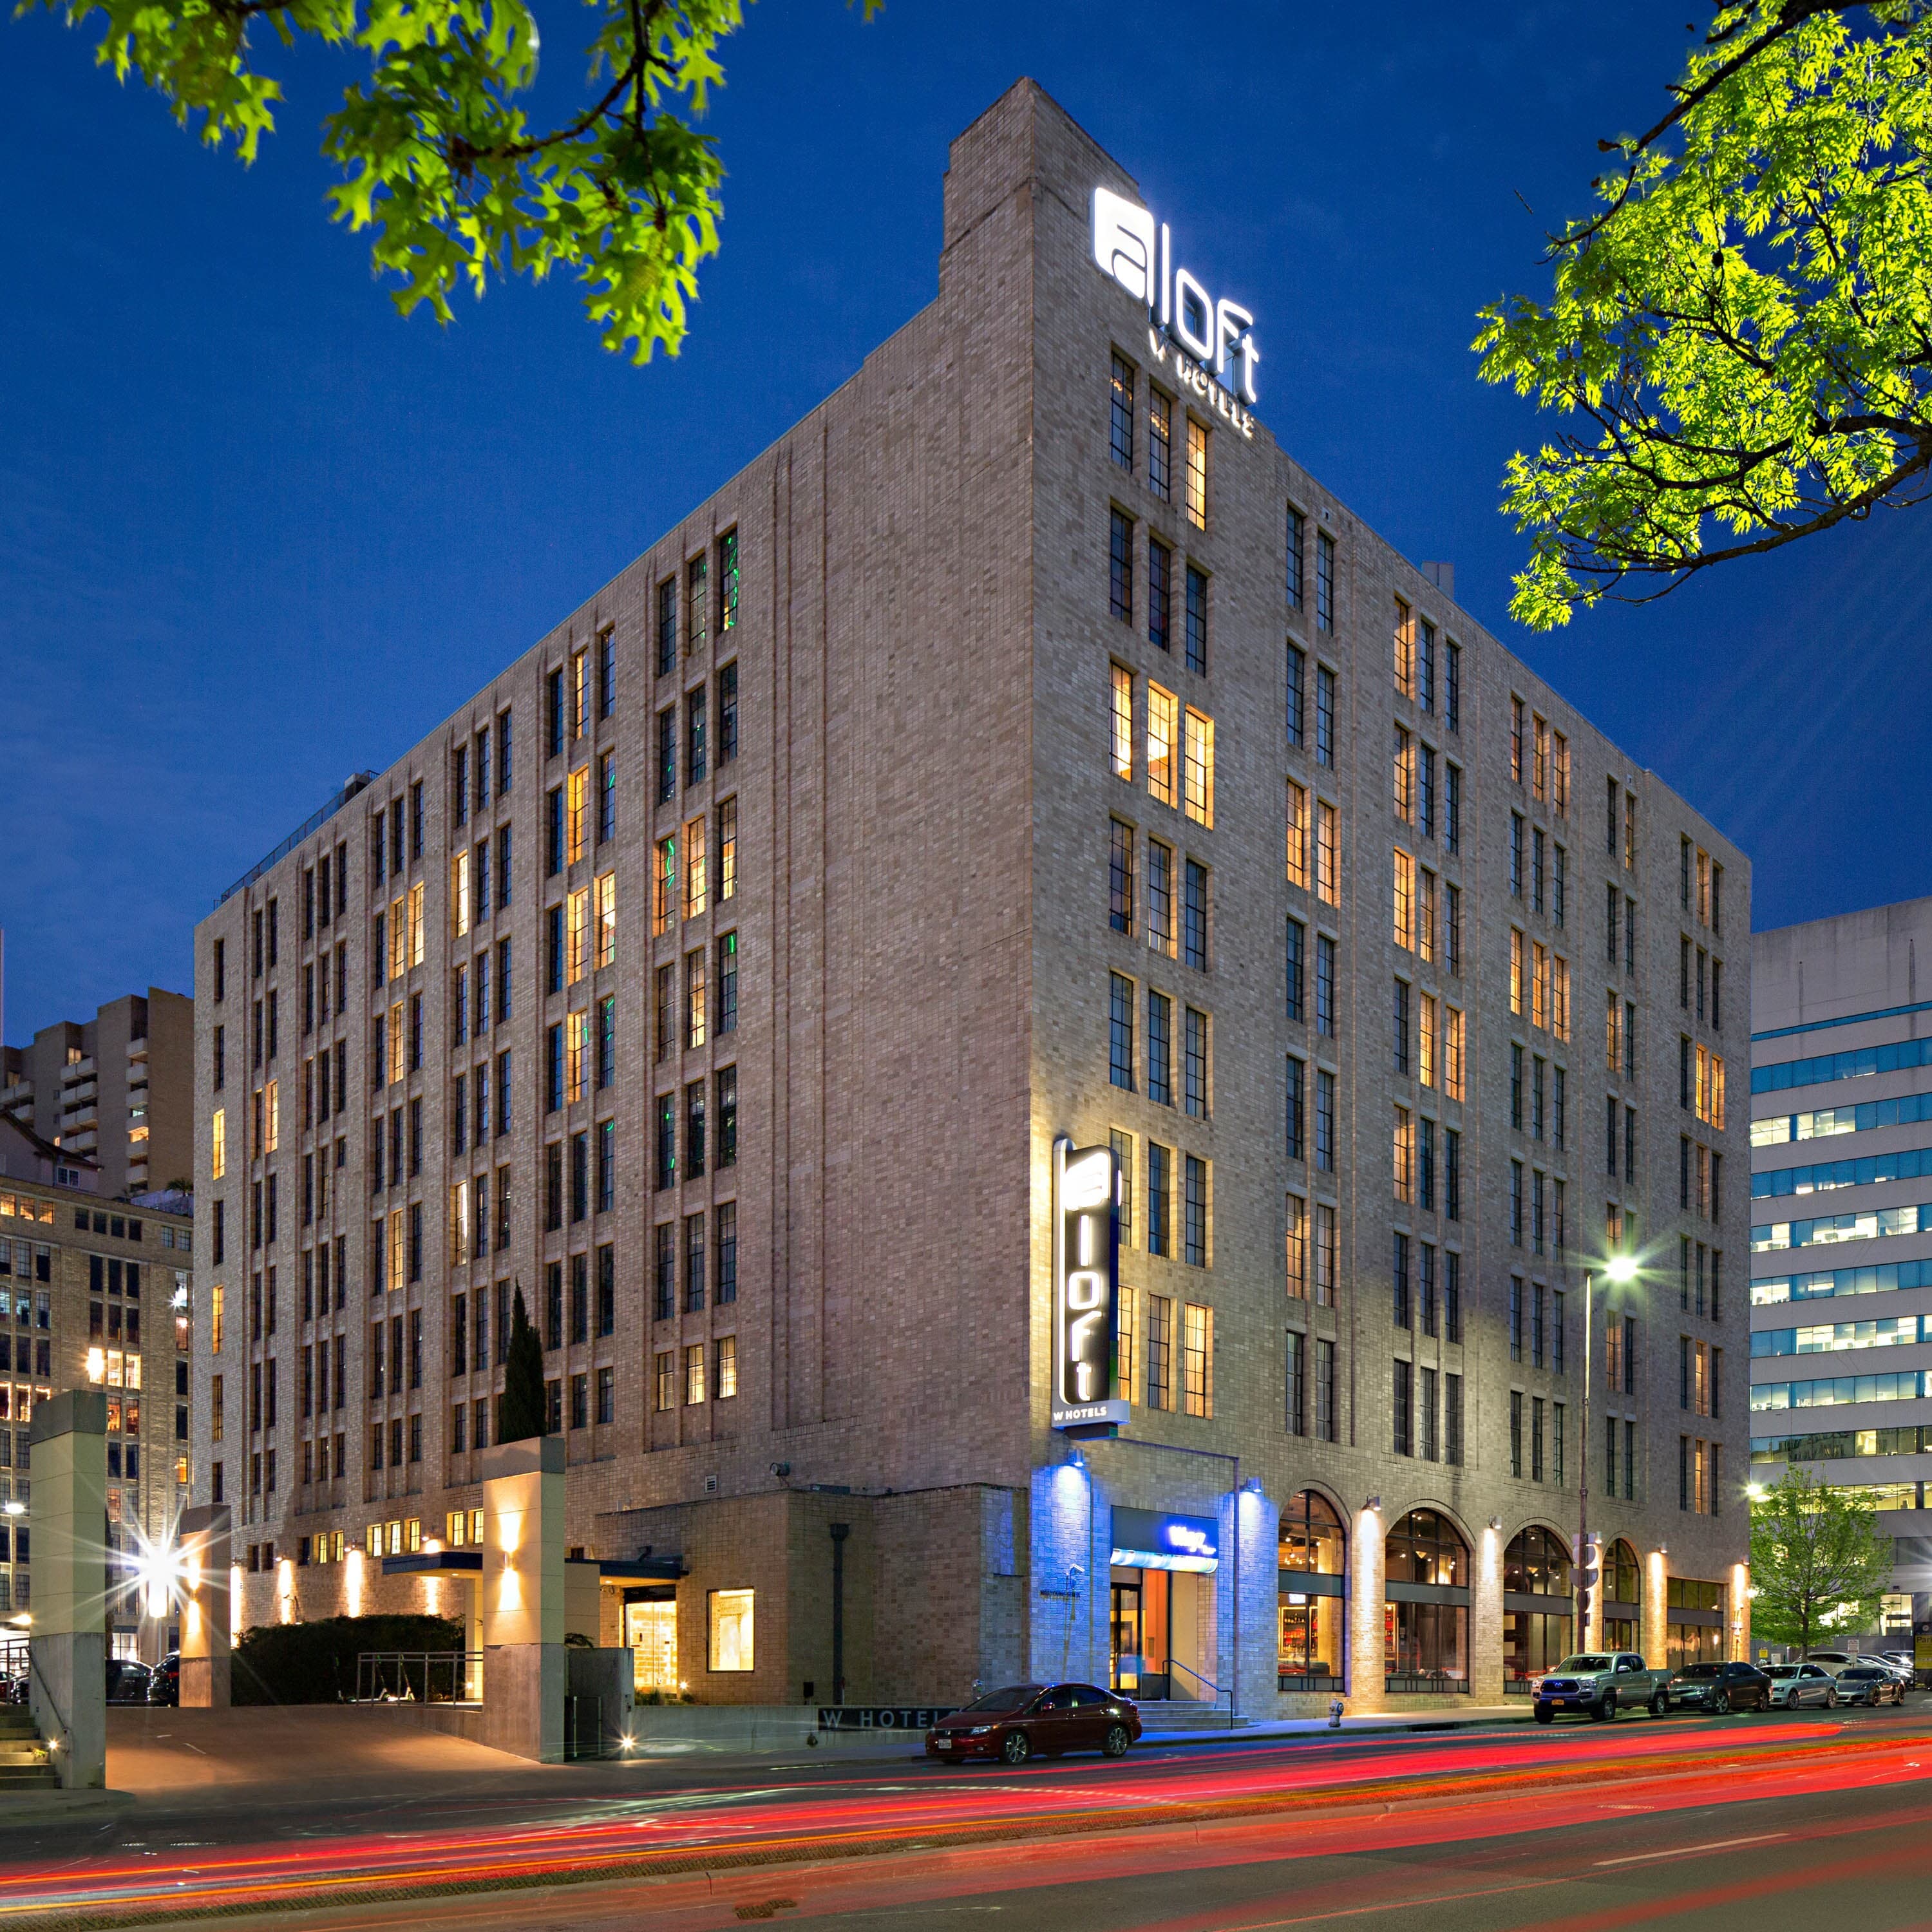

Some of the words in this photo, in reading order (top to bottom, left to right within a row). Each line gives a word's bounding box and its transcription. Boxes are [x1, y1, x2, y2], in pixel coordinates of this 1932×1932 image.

[1094, 186, 1260, 404] aloft
[1053, 1411, 1064, 1421] W
[1065, 1406, 1107, 1420] HOTELS
[822, 1710, 843, 1728] W
[860, 1710, 959, 1728] HOTE
